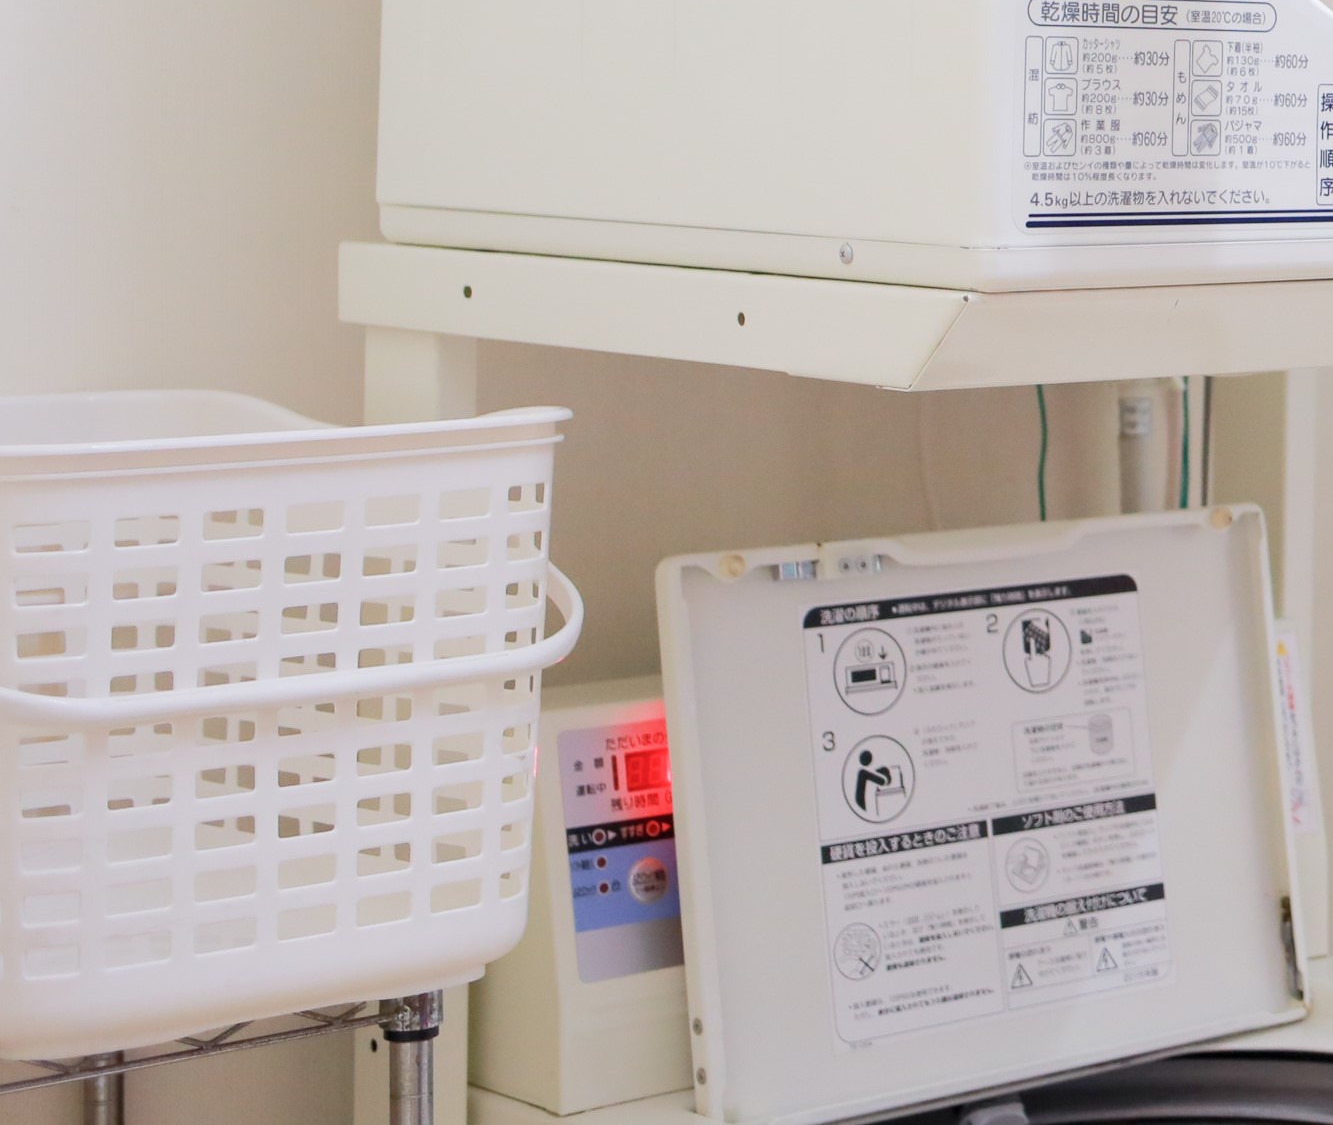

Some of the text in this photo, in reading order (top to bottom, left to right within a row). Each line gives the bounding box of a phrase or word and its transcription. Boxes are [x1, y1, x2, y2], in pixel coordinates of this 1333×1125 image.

[1041, 1, 1178, 26] 乾燥時間の目安
[1082, 51, 1170, 67] 約200g 約30分
[1274, 54, 1309, 69] 約60分
[1081, 79, 1121, 91] ブラウス
[1081, 91, 1169, 107] 約200g 約30分
[1273, 93, 1308, 108] 約60分
[1132, 131, 1168, 147] 約60分
[1272, 132, 1307, 147] 約60分
[1030, 190, 1271, 209] 4.5kg以上の洗濯物を入れないでください。
[986, 613, 999, 634] 2
[816, 633, 825, 653] 1
[605, 731, 668, 751] ただいまの
[821, 731, 836, 751] 3
